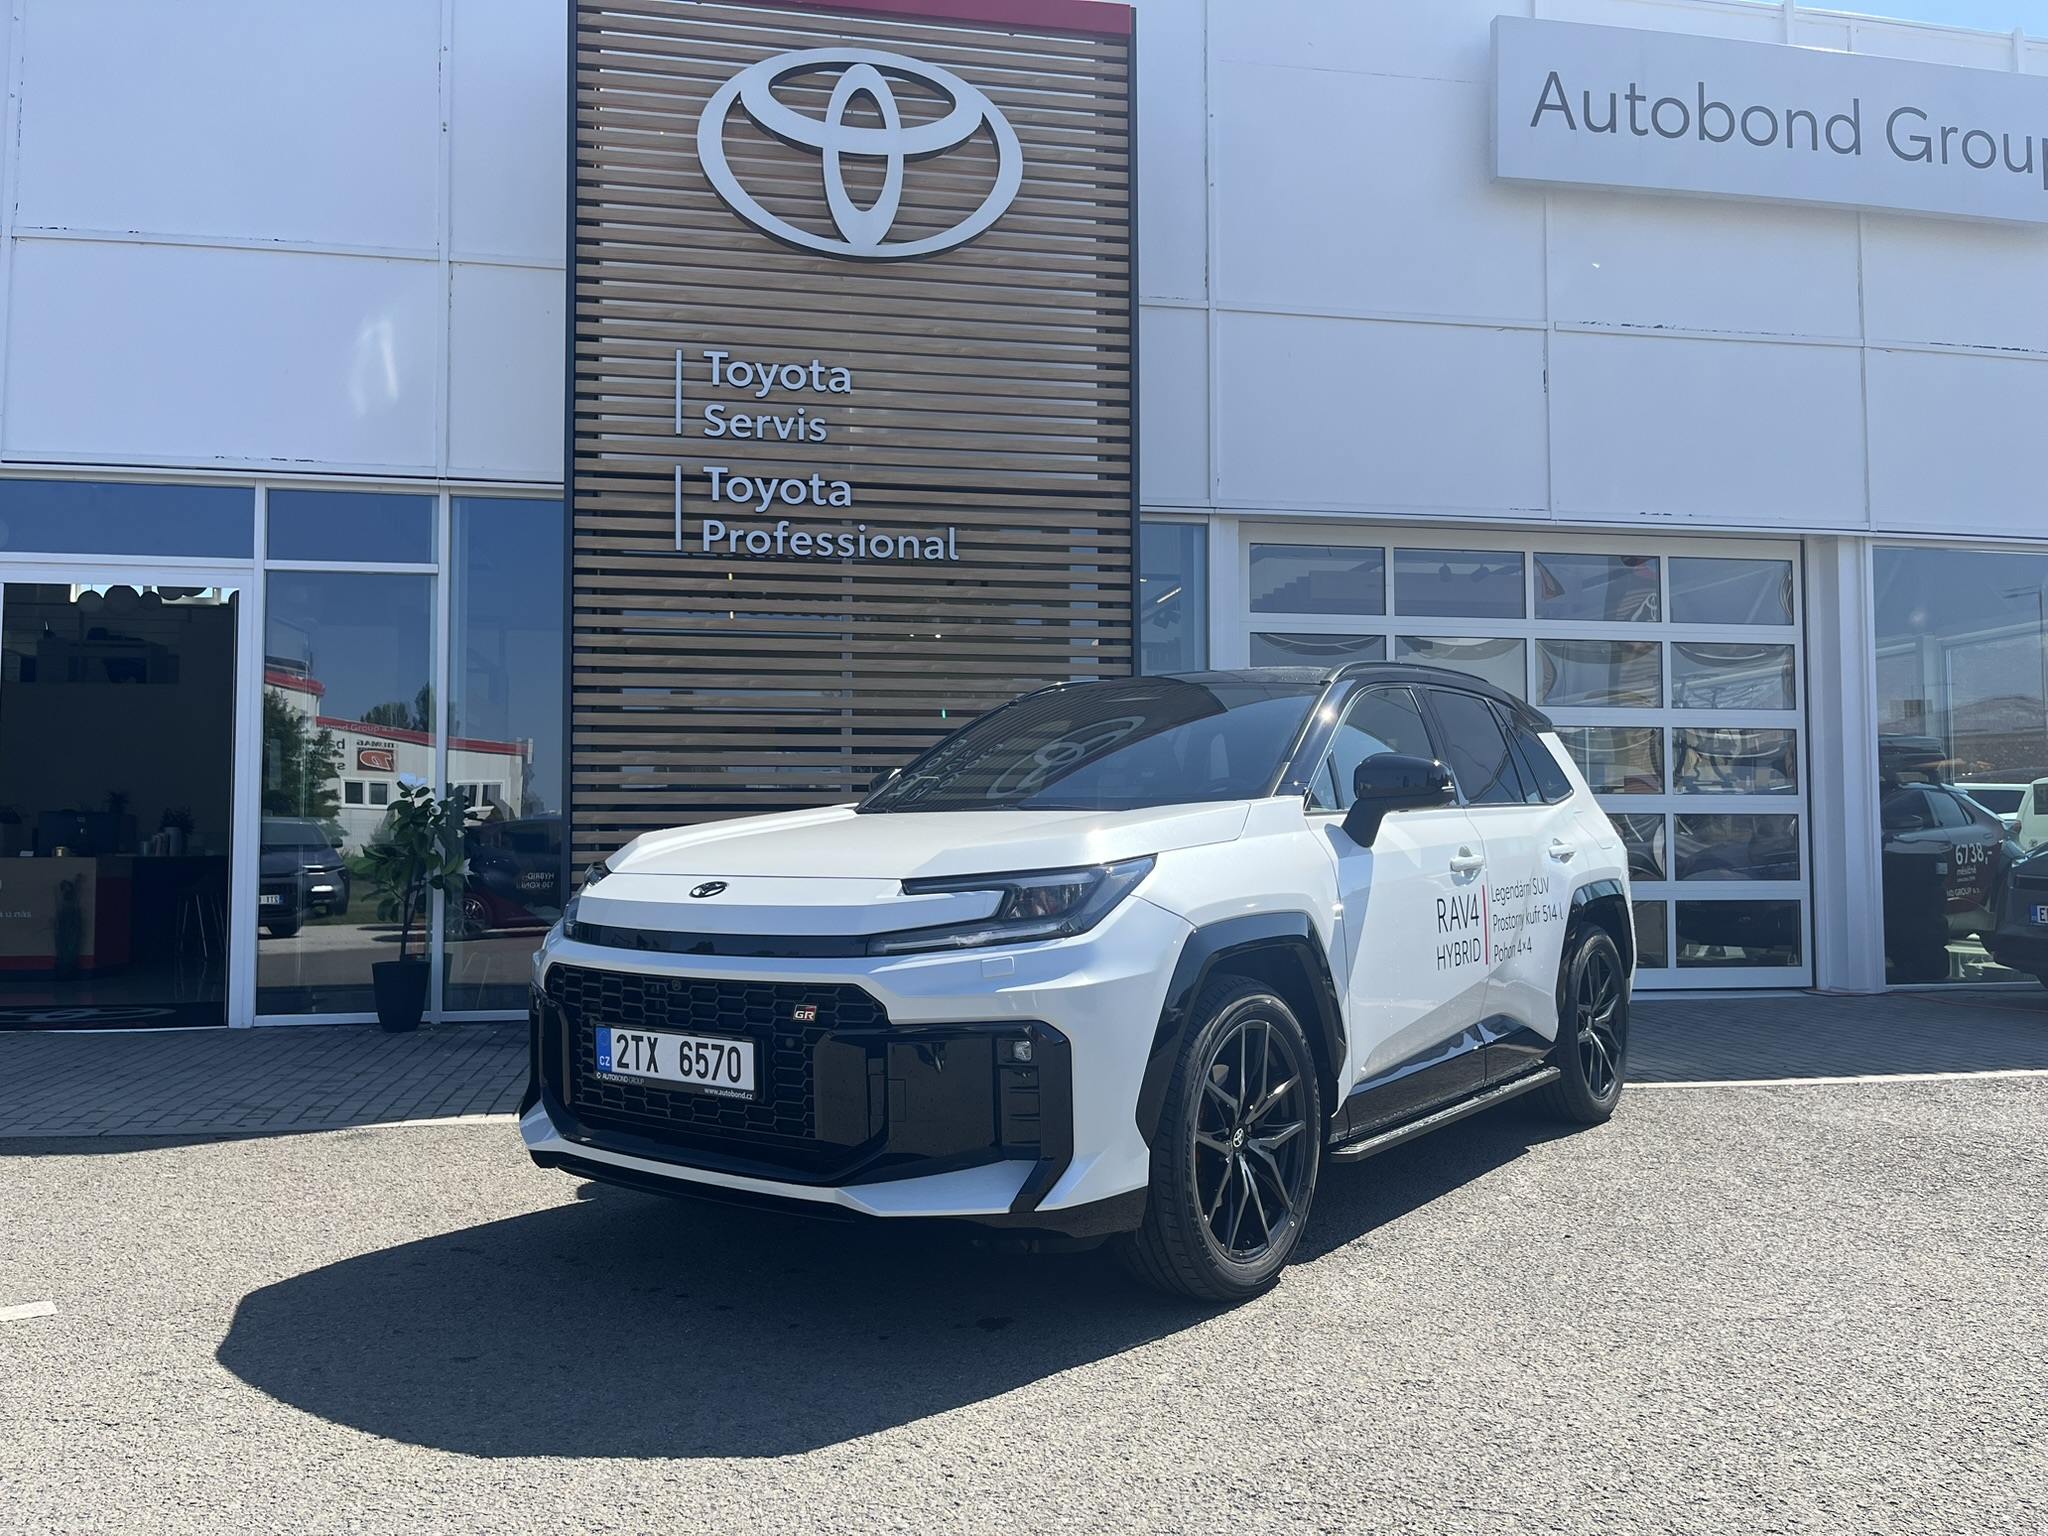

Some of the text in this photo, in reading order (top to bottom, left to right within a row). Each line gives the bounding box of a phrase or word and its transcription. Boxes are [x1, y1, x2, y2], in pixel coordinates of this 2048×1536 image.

[1530, 71, 1862, 156] Autobond
[703, 350, 851, 398] Toyota
[703, 403, 827, 442] Servis
[703, 465, 851, 513] Toyota
[703, 519, 959, 560] Professional
[350, 723, 380, 733] Group
[1955, 842, 1993, 865] 6738,-
[1491, 876, 1549, 906] Legendární SUV
[14, 909, 32, 918] nás
[1436, 893, 1480, 934] RAV4
[1492, 909, 1525, 933] Prostorný
[1525, 905, 1541, 925] kufr
[1542, 903, 1558, 922] 514
[1436, 938, 1481, 971] HYBRID
[1493, 941, 1516, 963] Pohon
[794, 1010, 815, 1020] GR
[599, 1055, 611, 1067] CZ
[616, 1033, 742, 1083] 2TX 6570
[602, 1073, 629, 1083] AUTOBOND
[704, 1087, 753, 1100] www.autobond.cz
